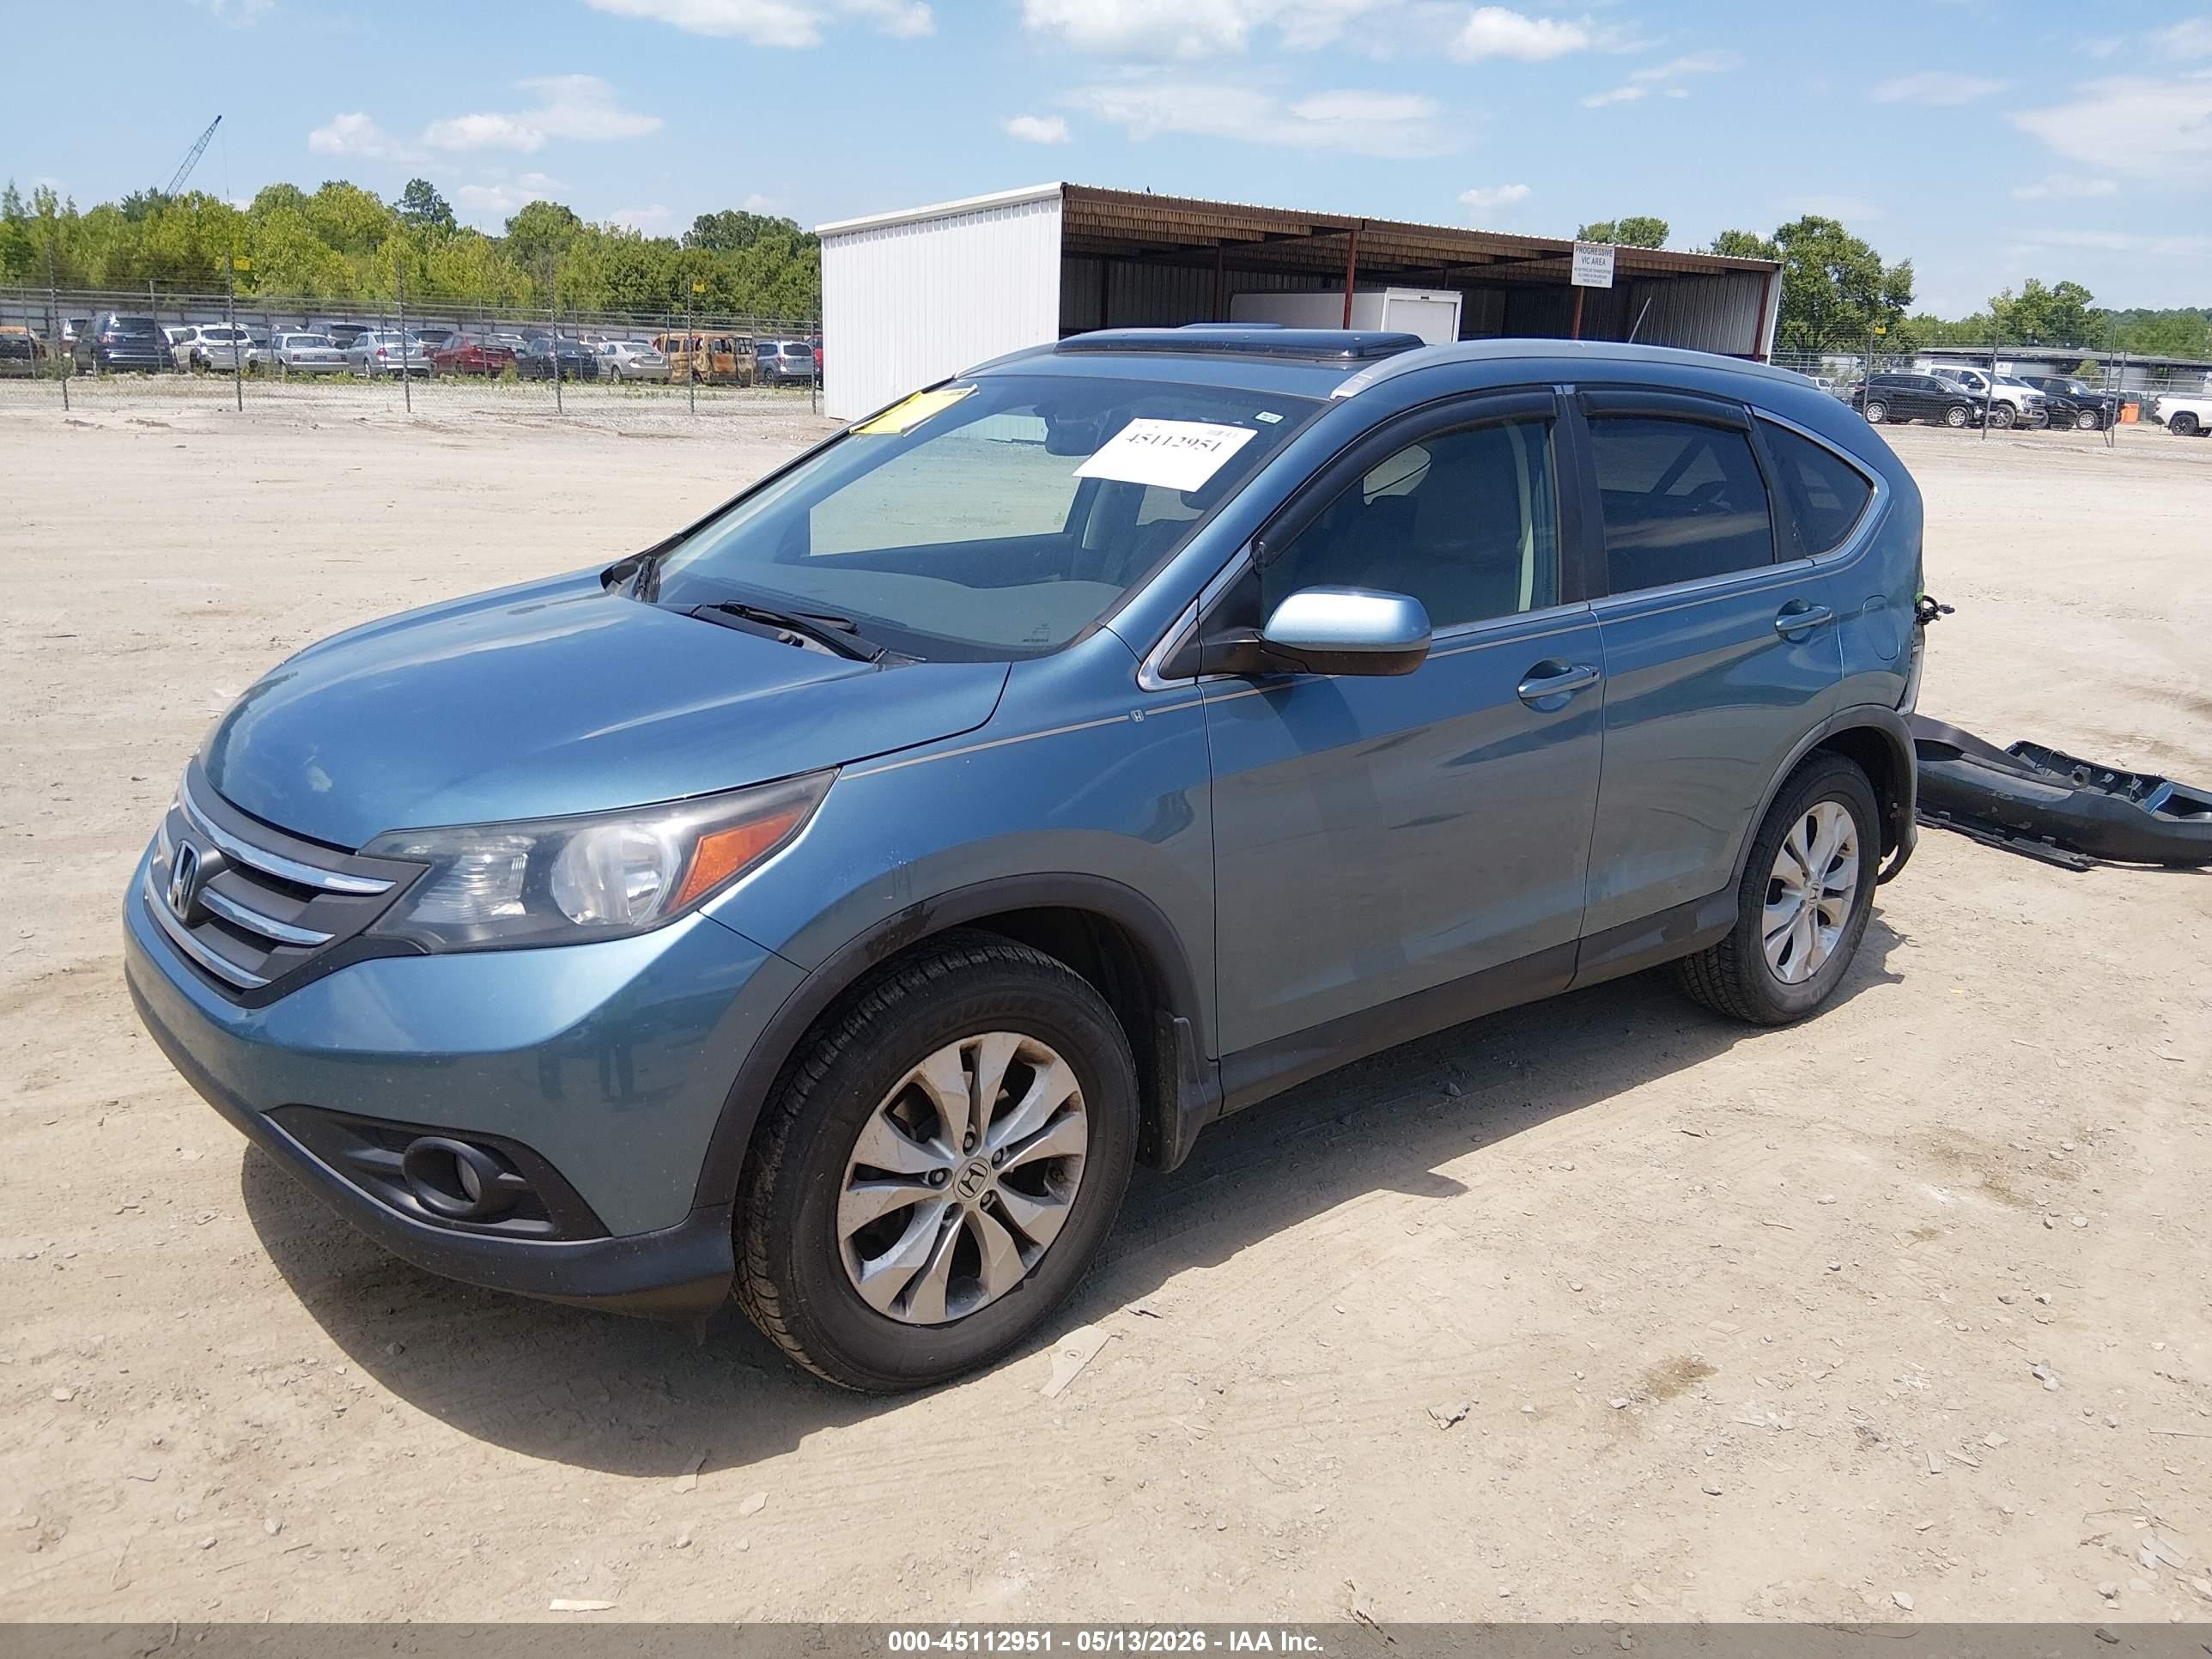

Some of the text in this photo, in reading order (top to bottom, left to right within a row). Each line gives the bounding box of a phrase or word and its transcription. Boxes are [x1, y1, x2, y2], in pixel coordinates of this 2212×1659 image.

[1575, 246, 1613, 258] PROGRESSIVE
[1591, 258, 1606, 266] AREA
[1127, 433, 1222, 452] 45112951
